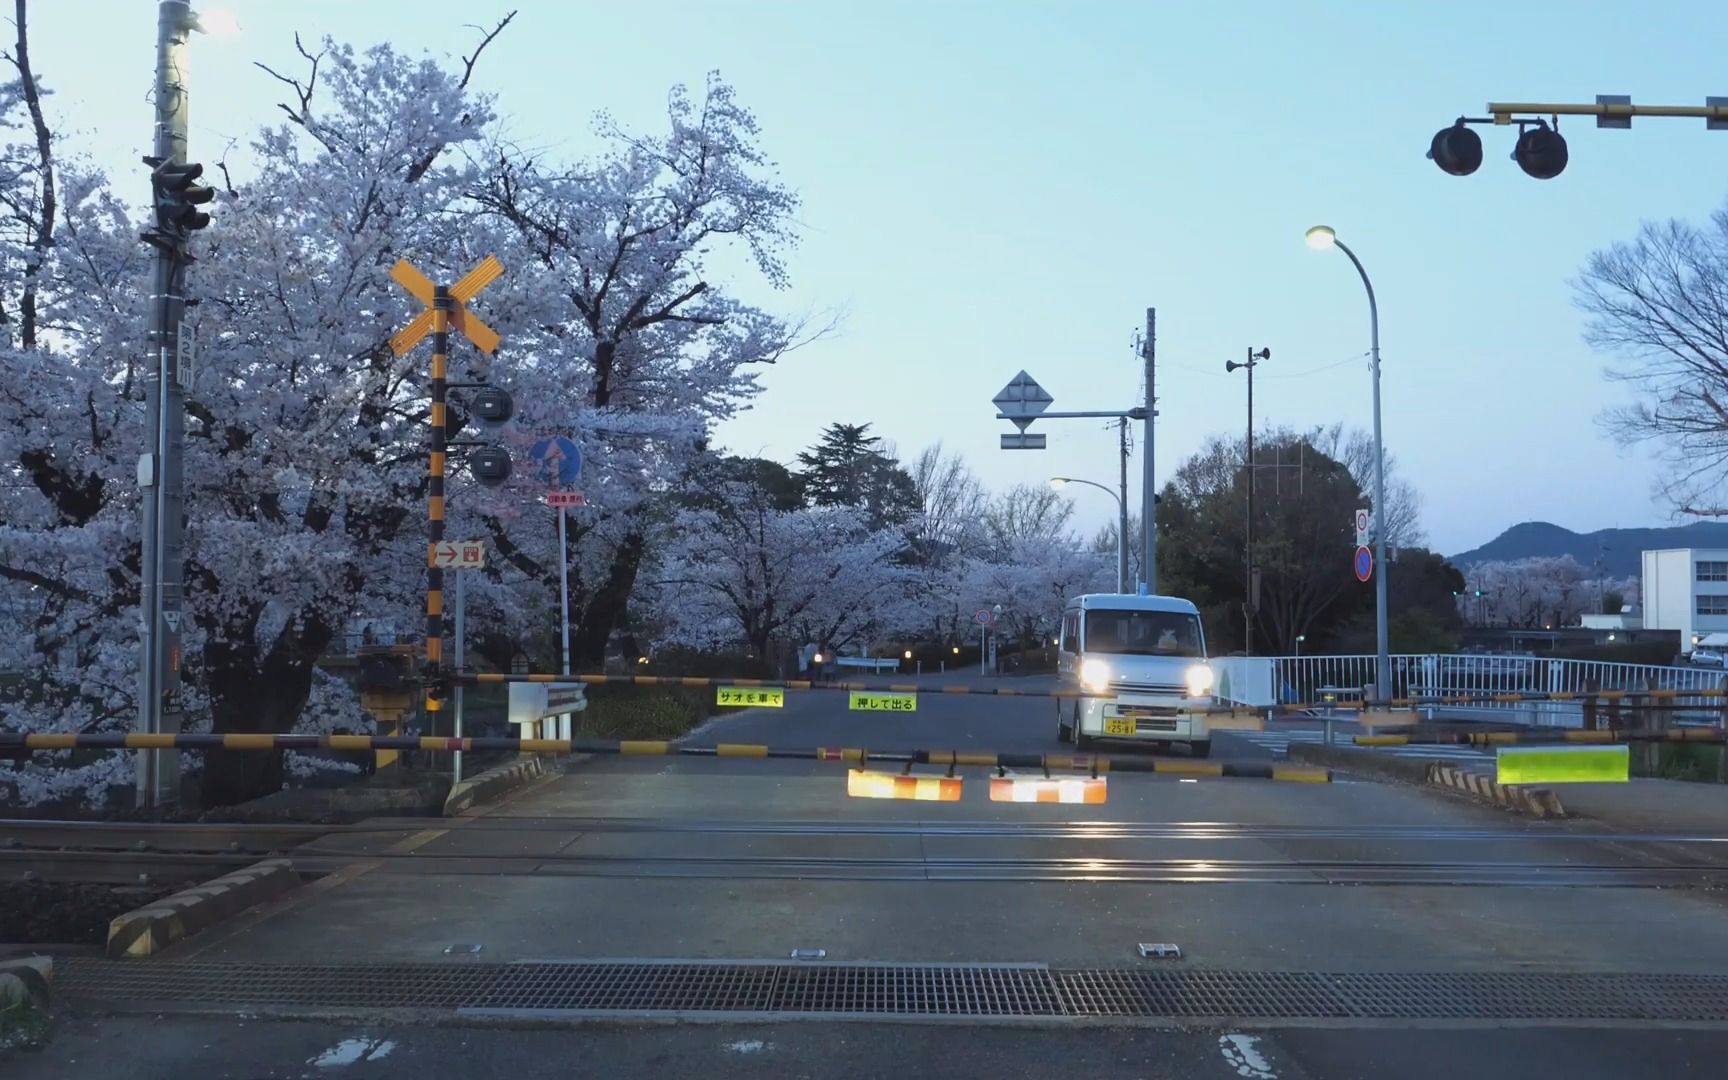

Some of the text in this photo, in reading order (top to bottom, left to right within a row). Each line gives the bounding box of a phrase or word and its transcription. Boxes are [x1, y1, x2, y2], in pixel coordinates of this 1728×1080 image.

[720, 692, 781, 704] サオを車で
[857, 698, 912, 710] 押して出る
